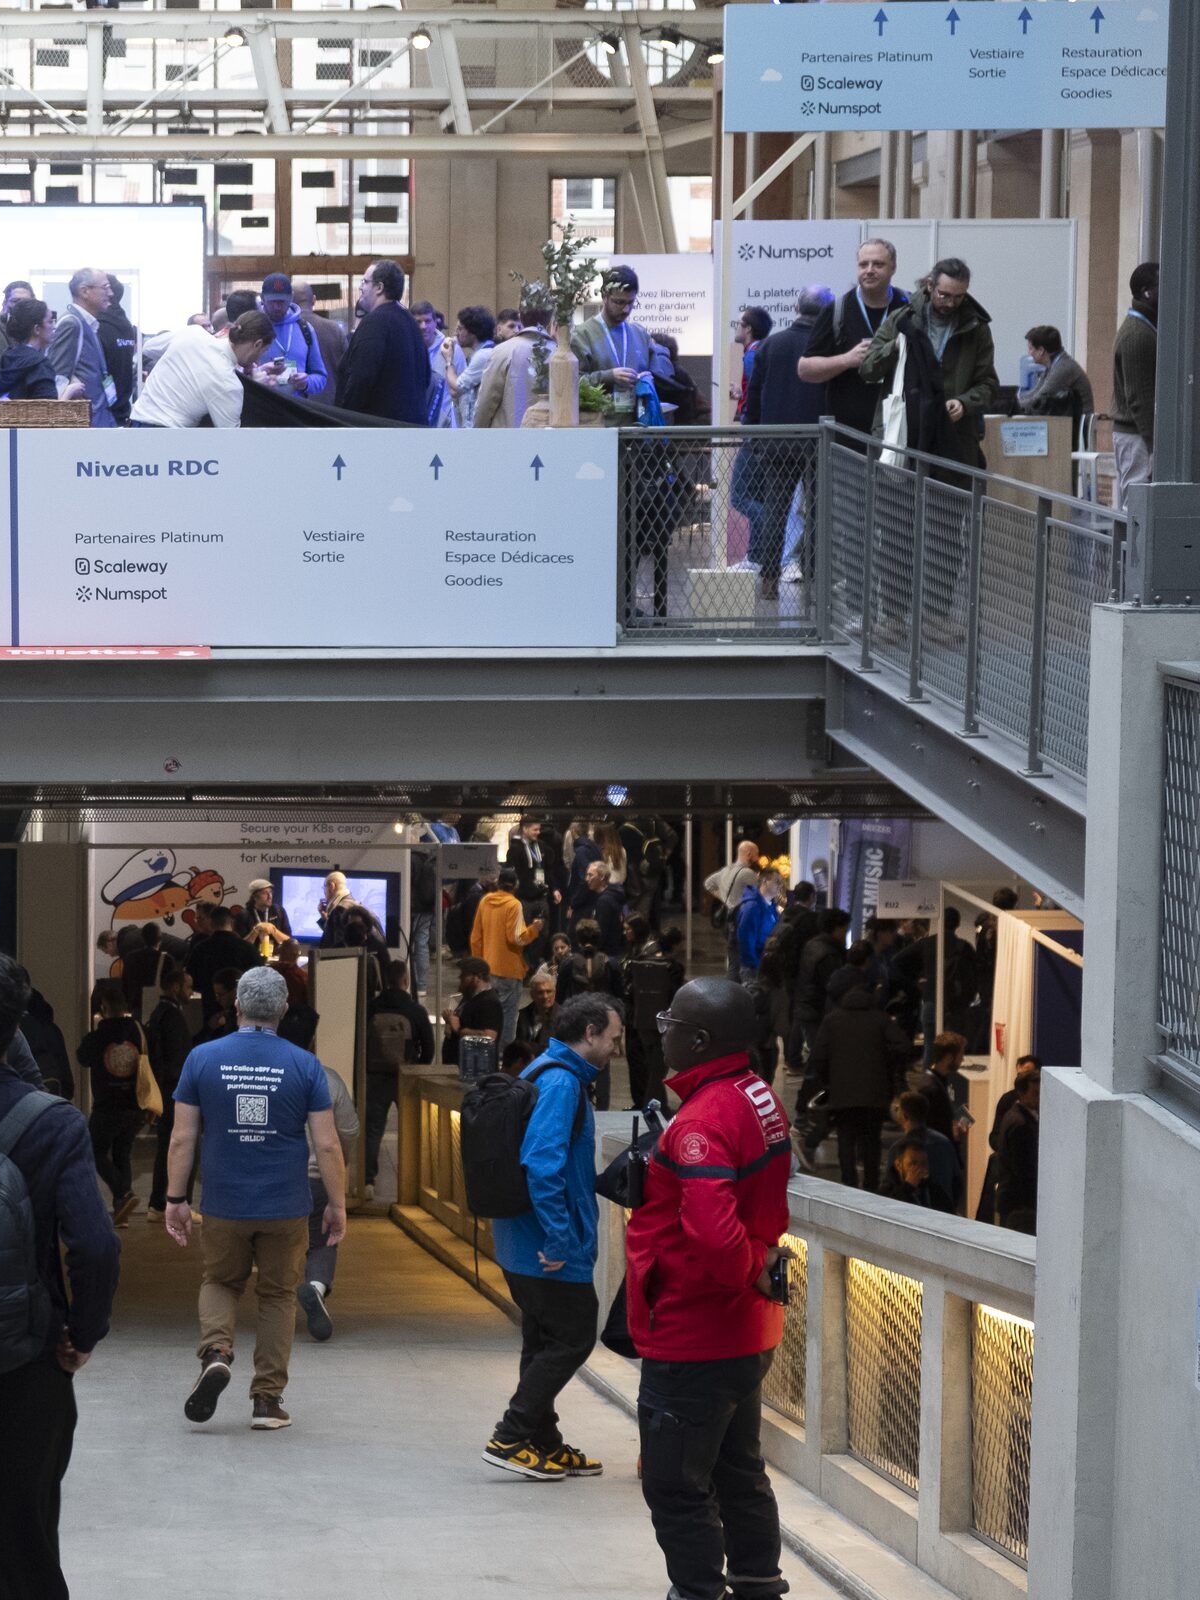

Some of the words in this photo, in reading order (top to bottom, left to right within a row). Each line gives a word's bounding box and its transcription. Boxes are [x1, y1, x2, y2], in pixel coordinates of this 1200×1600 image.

[801, 51, 874, 63] Partenaires
[877, 51, 933, 63] Platinum
[969, 48, 1025, 60] Vestiaire
[1061, 47, 1143, 58] Restauration
[968, 67, 1007, 79] Sortie
[1061, 66, 1107, 80] Espace
[1111, 65, 1168, 77] Dédicace
[817, 76, 884, 92] Scaleway
[1060, 87, 1113, 100] Goodies
[818, 102, 882, 117] Numspot
[758, 244, 834, 262] Numspot
[660, 289, 707, 298] librement
[747, 287, 761, 298] La
[659, 302, 696, 312] gardant
[76, 460, 159, 478] Niveau
[168, 459, 219, 476] RDC
[75, 532, 156, 545] Partenaires
[161, 531, 224, 543] Platinum
[302, 530, 365, 542] Vestiaire
[445, 529, 537, 542] Restauration
[302, 550, 345, 563] Sortie
[445, 551, 496, 566] Espace
[501, 550, 575, 564] Dédicaces
[93, 559, 168, 576] Scaleway
[444, 574, 504, 587] Goodies
[95, 586, 168, 604] Numspot
[240, 823, 281, 834] Secure
[283, 824, 309, 837] your
[312, 823, 335, 834] K8s
[337, 824, 374, 838] cargo.
[241, 853, 257, 863] for
[260, 853, 331, 863] Kubernetes.
[863, 847, 885, 906] MUSIC
